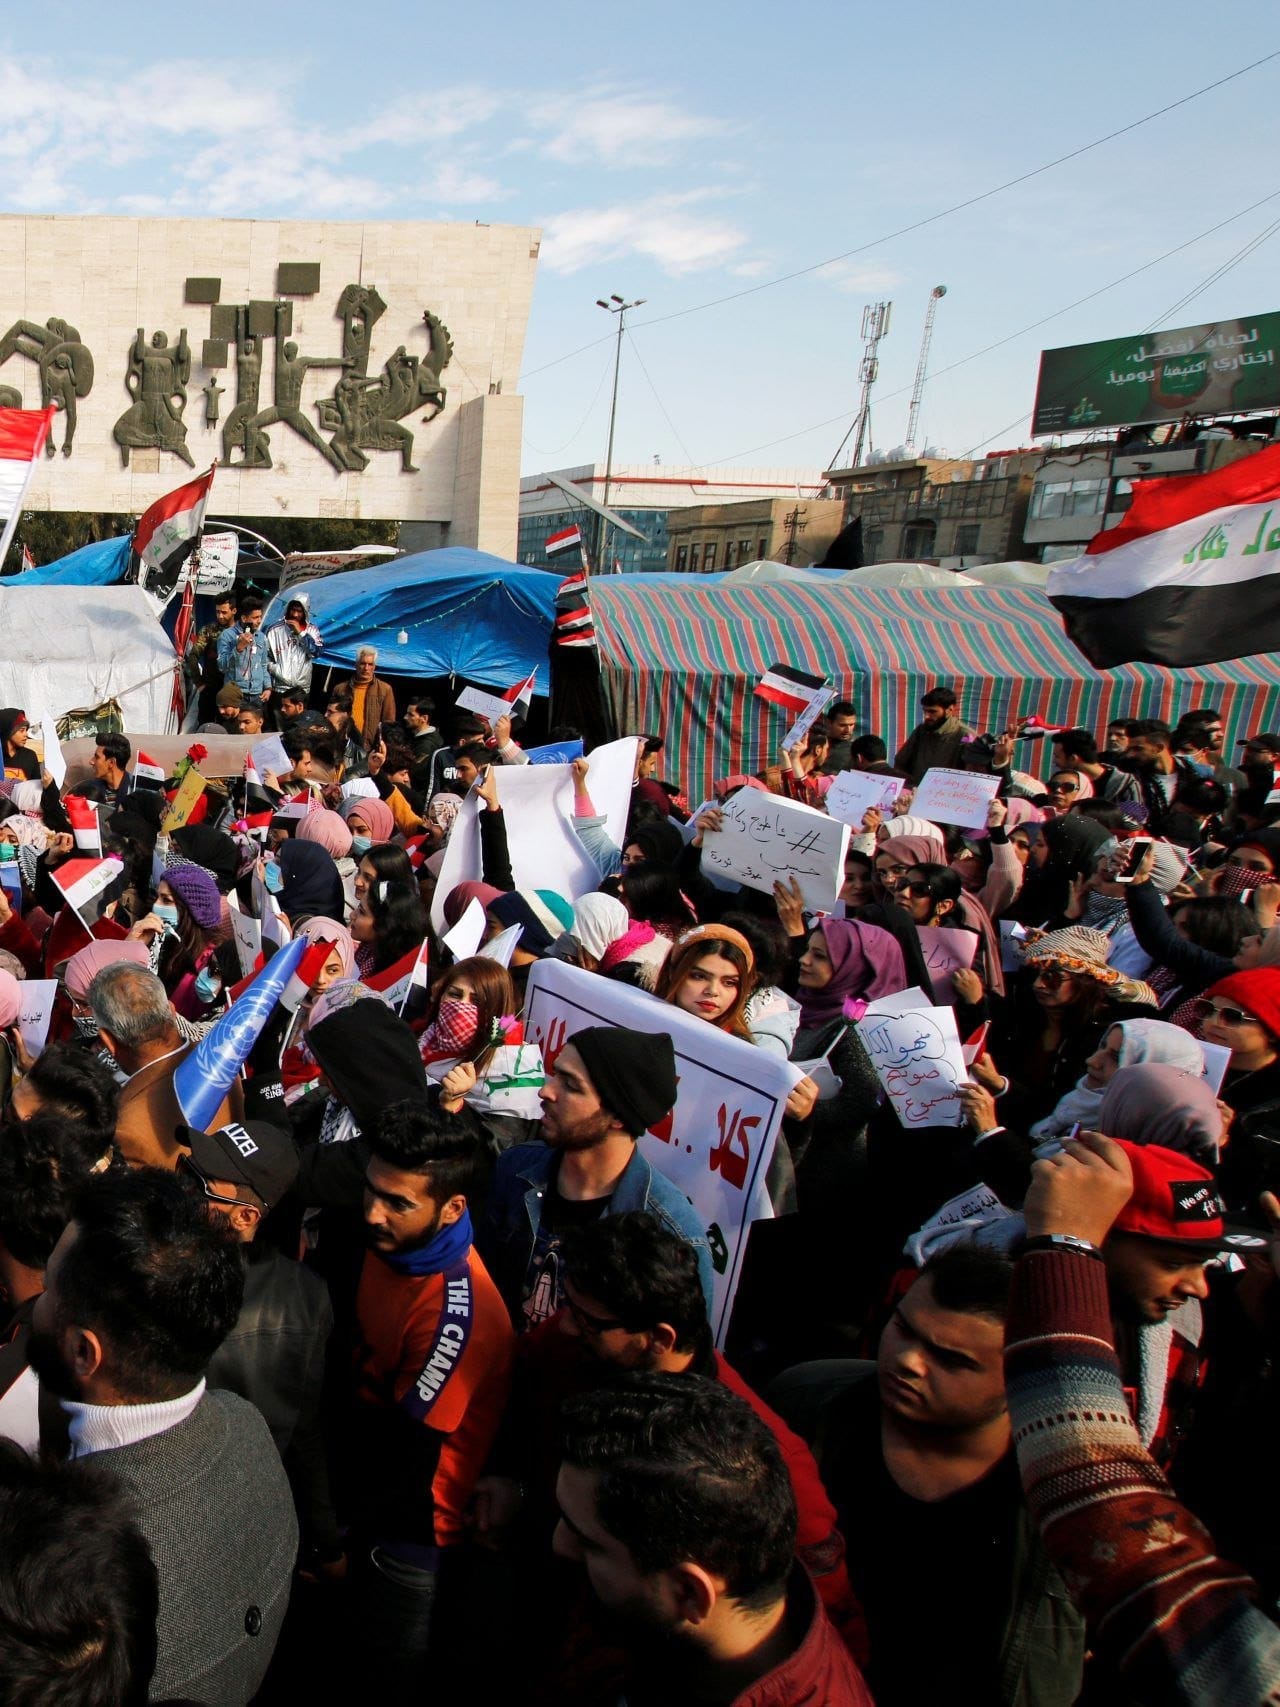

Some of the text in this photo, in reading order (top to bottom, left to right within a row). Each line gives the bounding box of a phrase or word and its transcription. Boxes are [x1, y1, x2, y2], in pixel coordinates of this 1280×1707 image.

[1205, 328, 1258, 349] لحياة
[443, 766, 458, 780] GIV
[221, 1122, 259, 1157] LIZEI
[447, 1277, 470, 1317] THE
[416, 1323, 464, 1402] CHAMP
